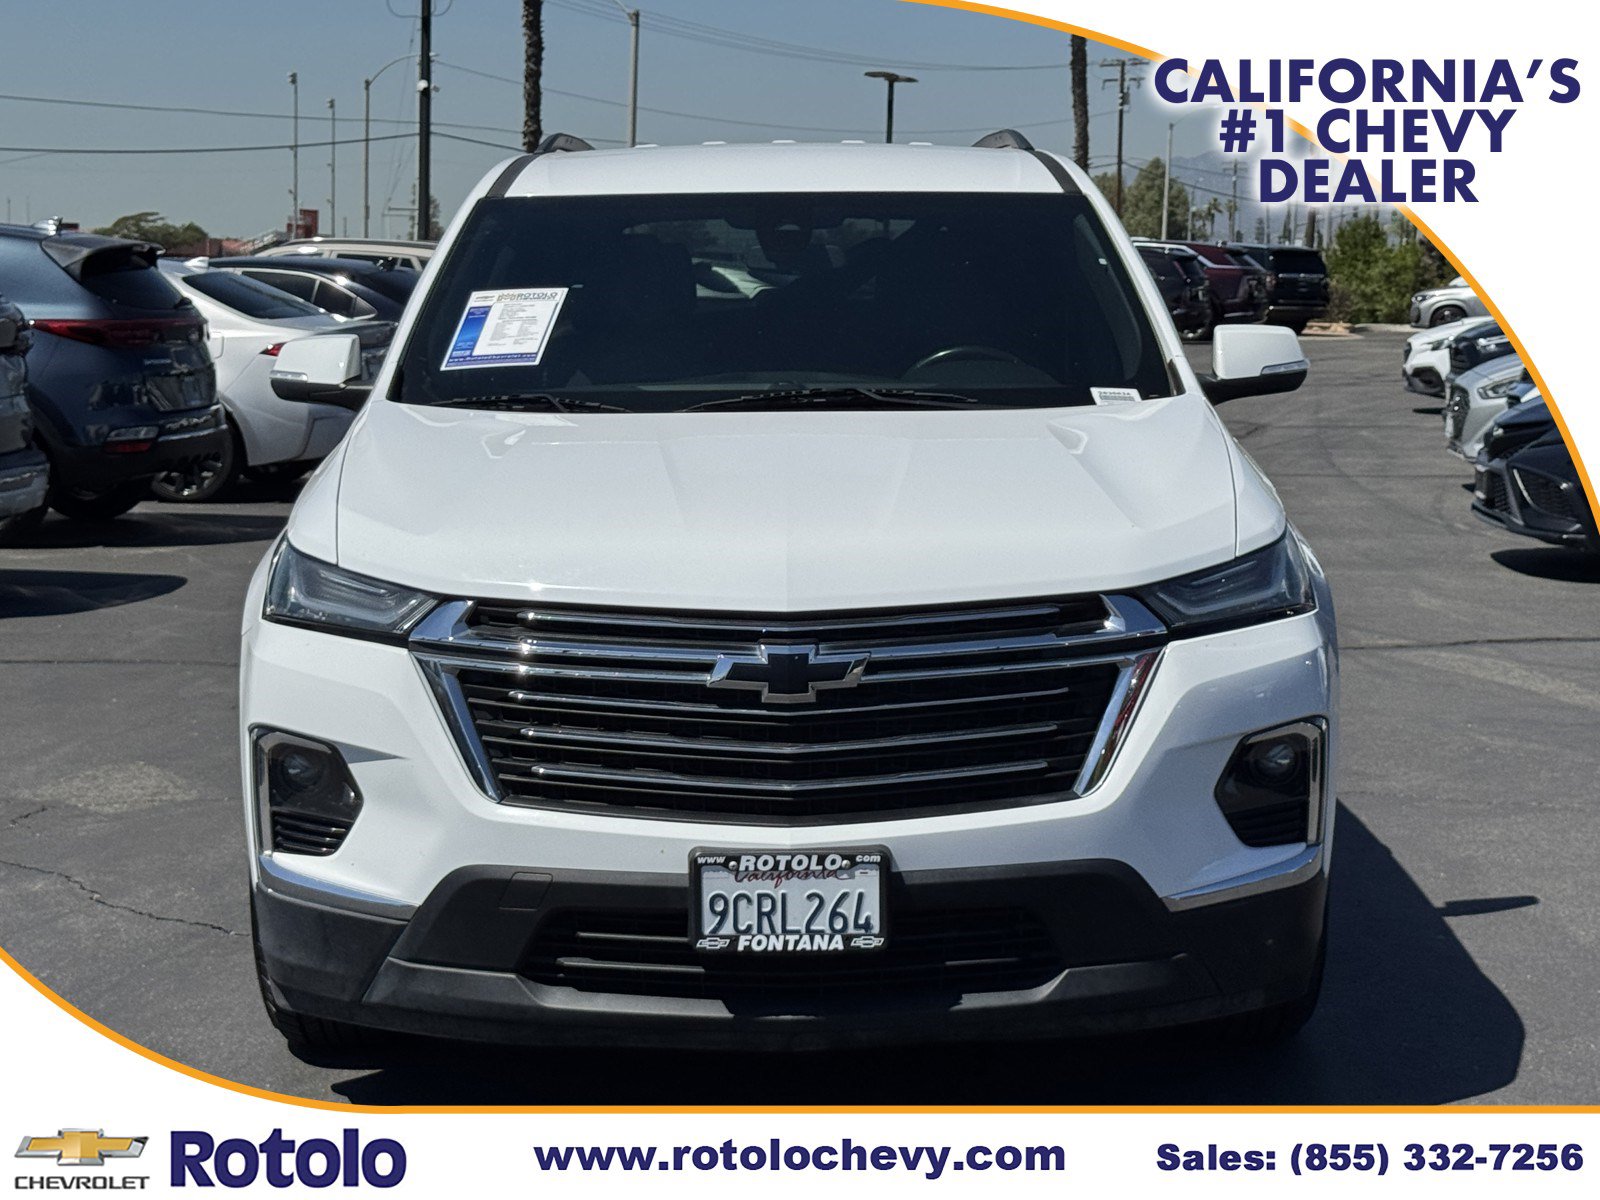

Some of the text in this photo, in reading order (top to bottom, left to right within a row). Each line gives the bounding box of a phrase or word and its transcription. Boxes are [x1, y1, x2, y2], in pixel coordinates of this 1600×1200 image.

[738, 853, 843, 872] ROTOLO
[707, 890, 874, 935] 9CRL264
[736, 934, 845, 952] FONTANA
